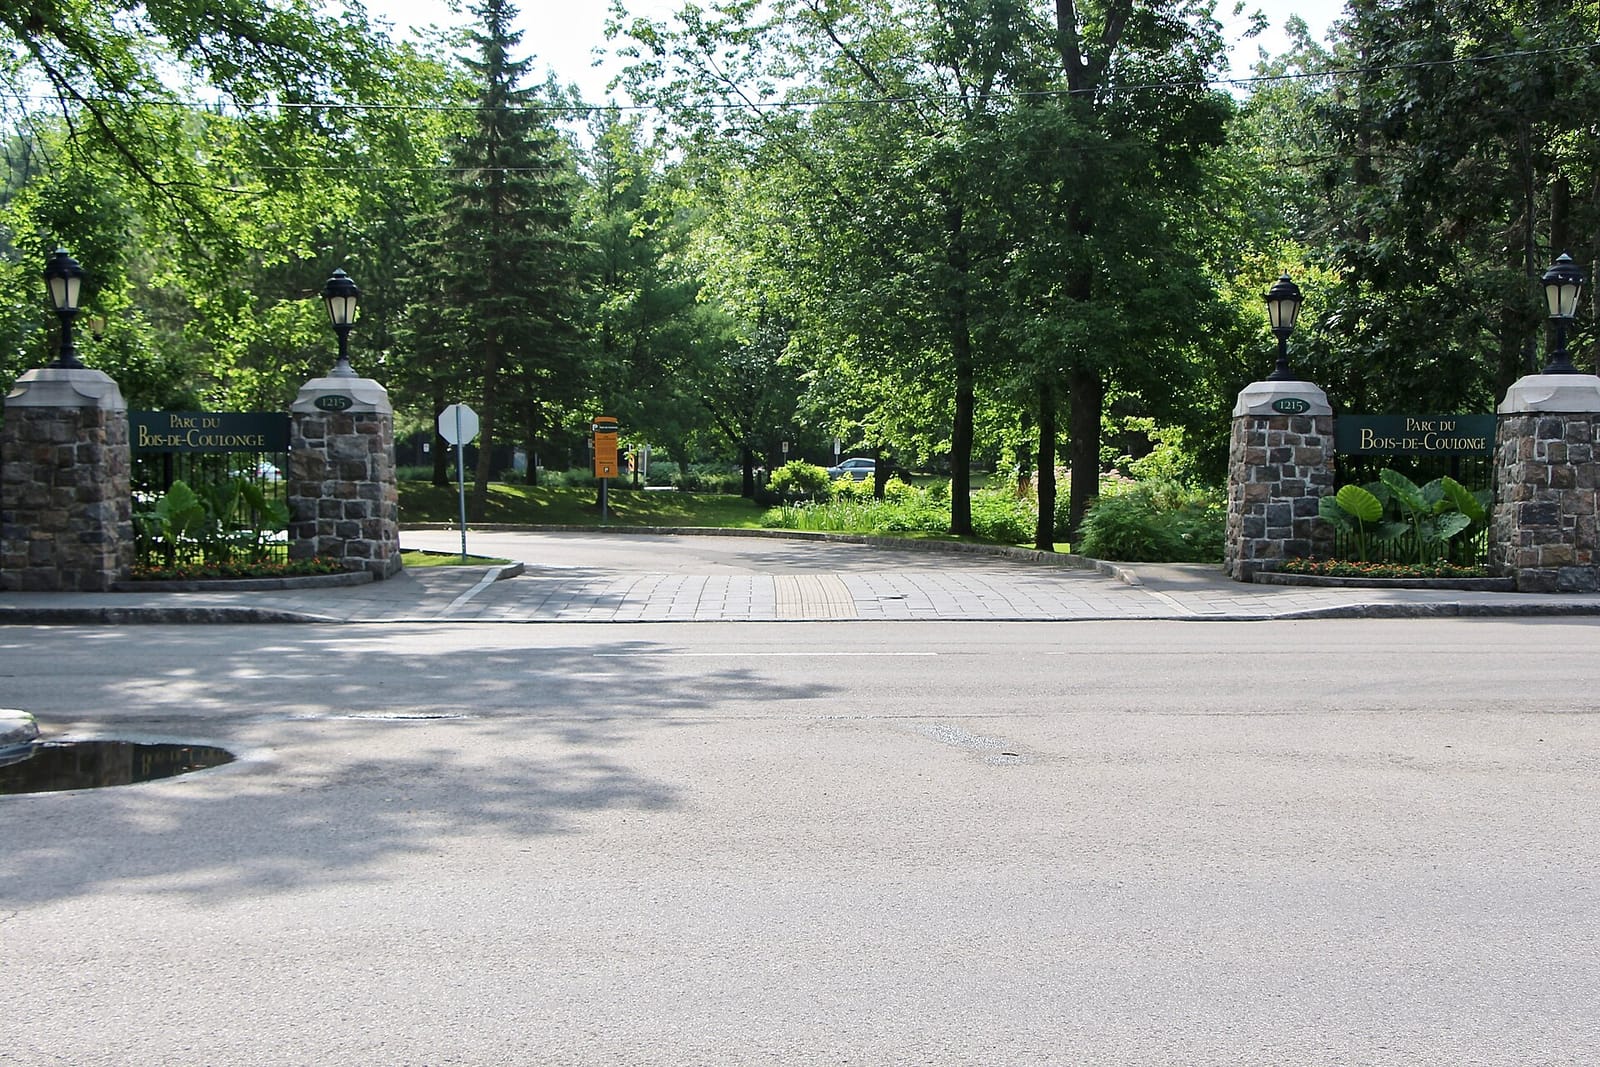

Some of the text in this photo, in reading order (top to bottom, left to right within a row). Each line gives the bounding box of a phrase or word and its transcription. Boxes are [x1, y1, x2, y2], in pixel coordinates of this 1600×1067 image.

[322, 397, 345, 408] 1215
[1280, 401, 1303, 412] 1215
[170, 414, 198, 428] PARC
[1406, 417, 1436, 432] PARC
[139, 425, 265, 447] BOIS-DE-COULONGE
[1360, 428, 1486, 450] BOIS-DE-COULONGE
